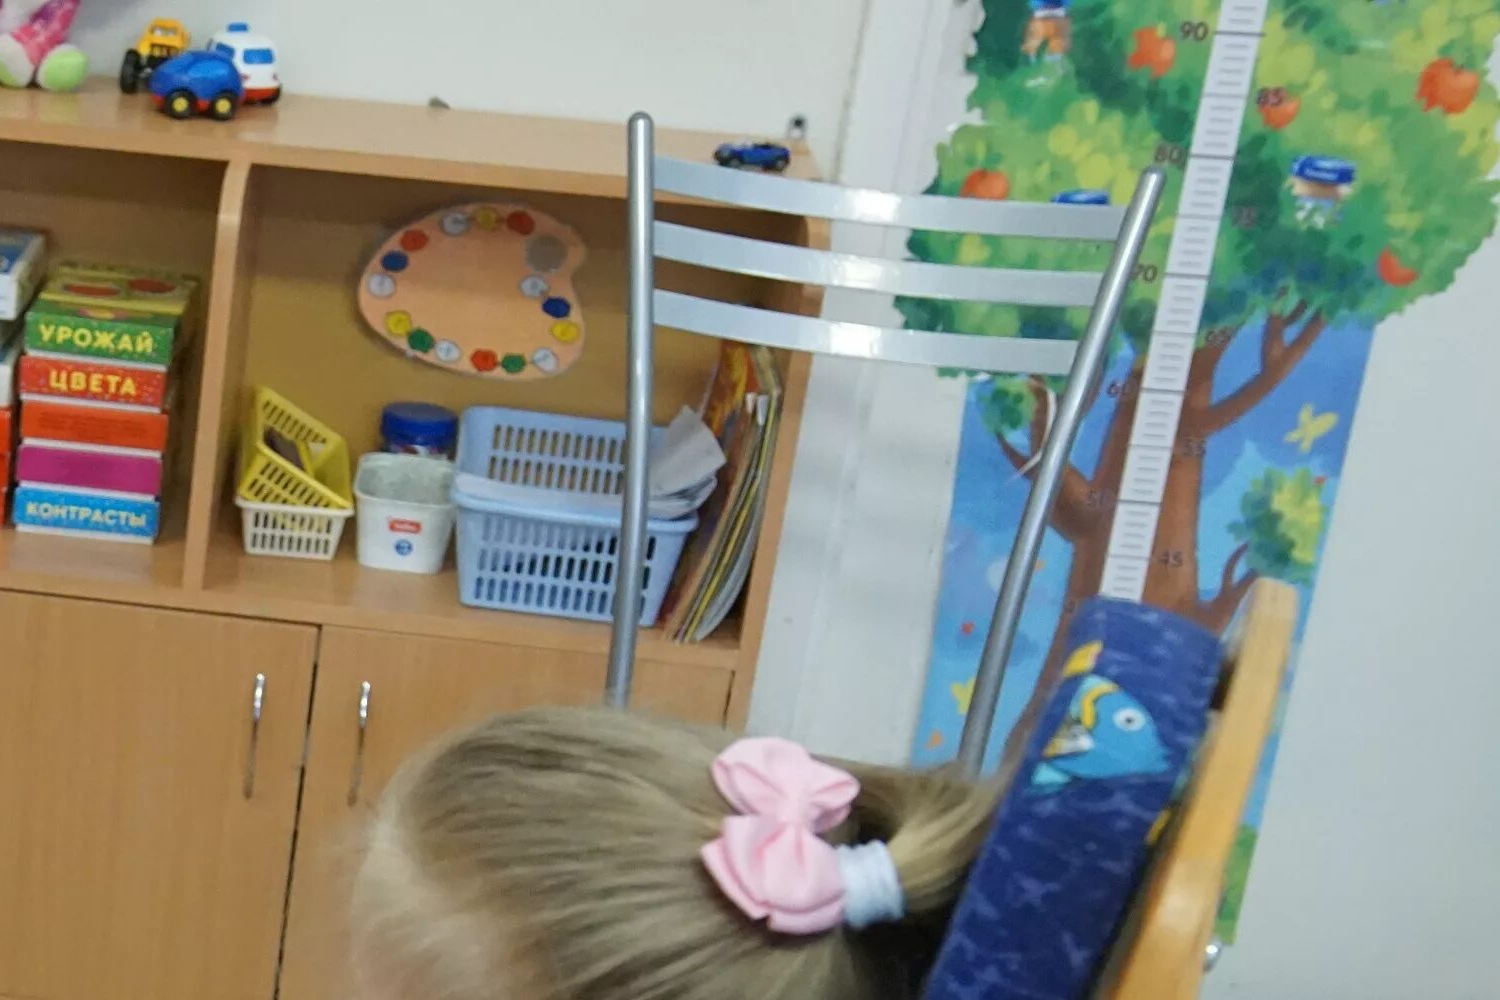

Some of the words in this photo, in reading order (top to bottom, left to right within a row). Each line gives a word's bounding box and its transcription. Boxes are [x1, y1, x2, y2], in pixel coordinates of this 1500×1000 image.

[1180, 21, 1209, 42] 90
[1154, 144, 1184, 163] 80
[39, 324, 154, 353] УРОЖАЙ
[49, 368, 137, 397] ЦВЕТА
[26, 502, 147, 527] КОНТРАСТЫ
